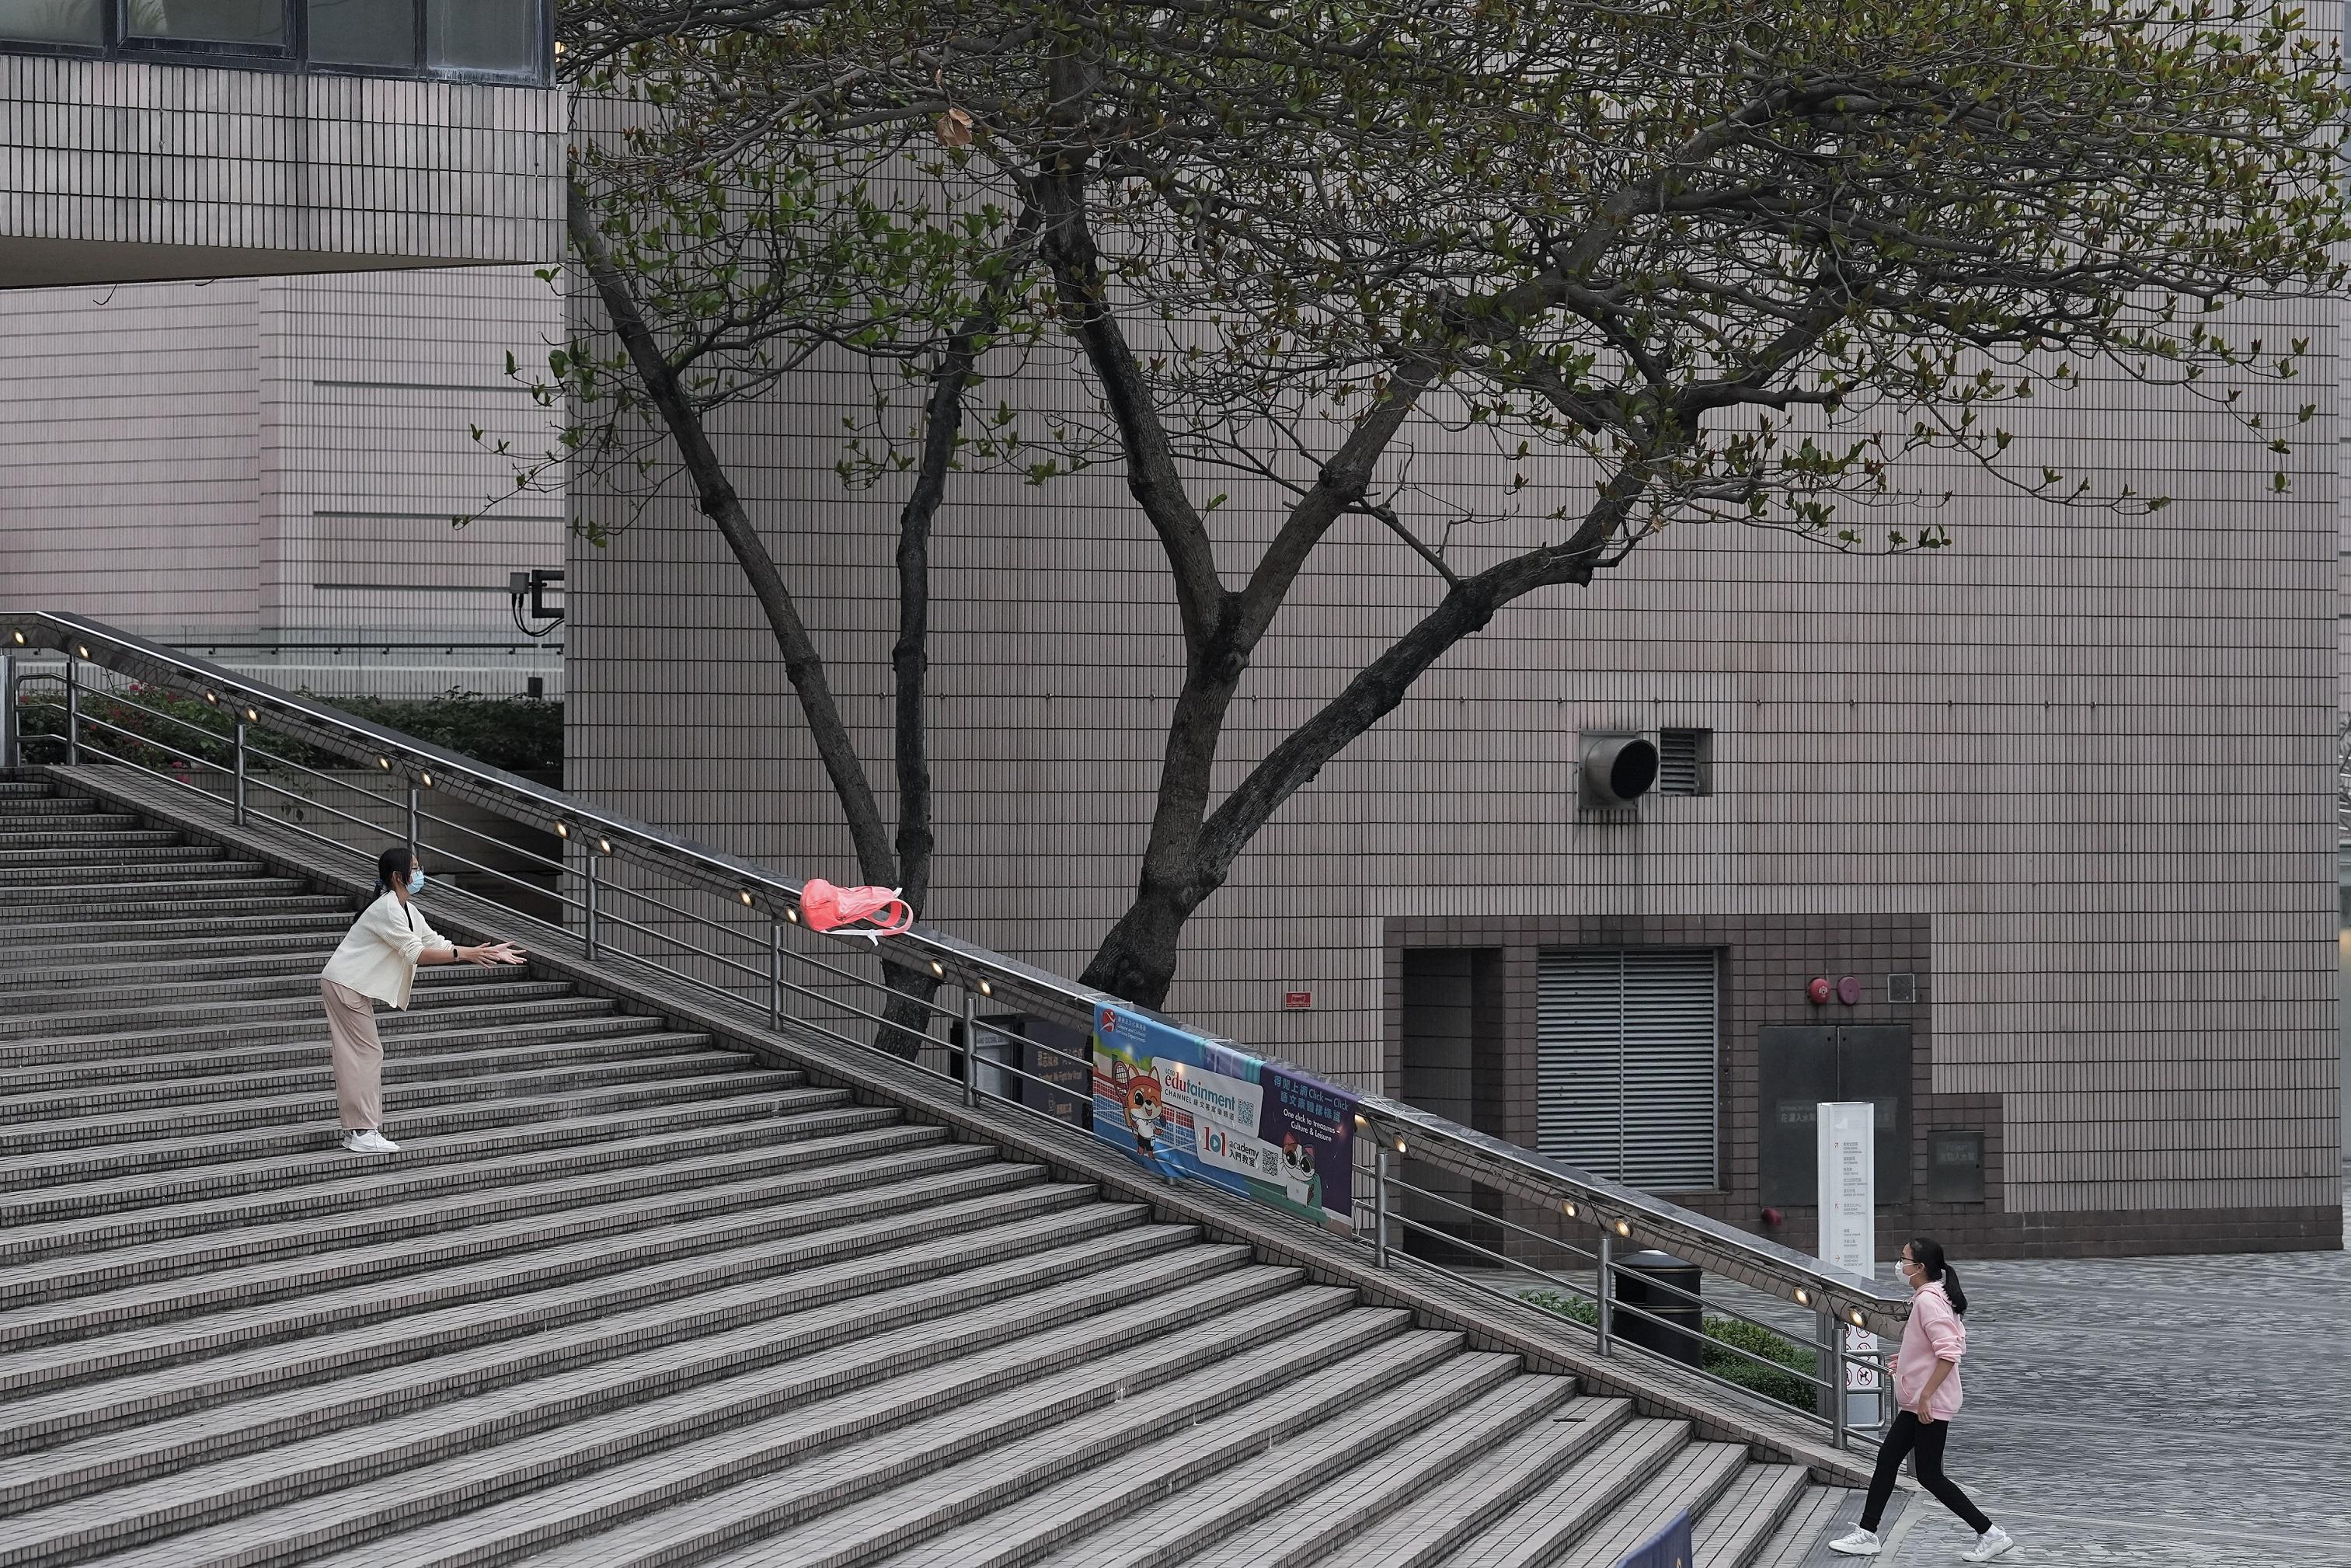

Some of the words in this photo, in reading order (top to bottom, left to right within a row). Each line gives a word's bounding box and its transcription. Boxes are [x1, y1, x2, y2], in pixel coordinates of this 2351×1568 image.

[1165, 1071, 1236, 1111] edutainment
[1165, 1089, 1192, 1104] CHANNEL
[1283, 1108, 1294, 1119] One
[1294, 1113, 1306, 1124] click
[1313, 1120, 1336, 1134] treasures
[1290, 1120, 1308, 1134] Culture
[1309, 1127, 1315, 1136] &
[1315, 1129, 1332, 1142] Leisure
[1229, 1139, 1259, 1160] academy
